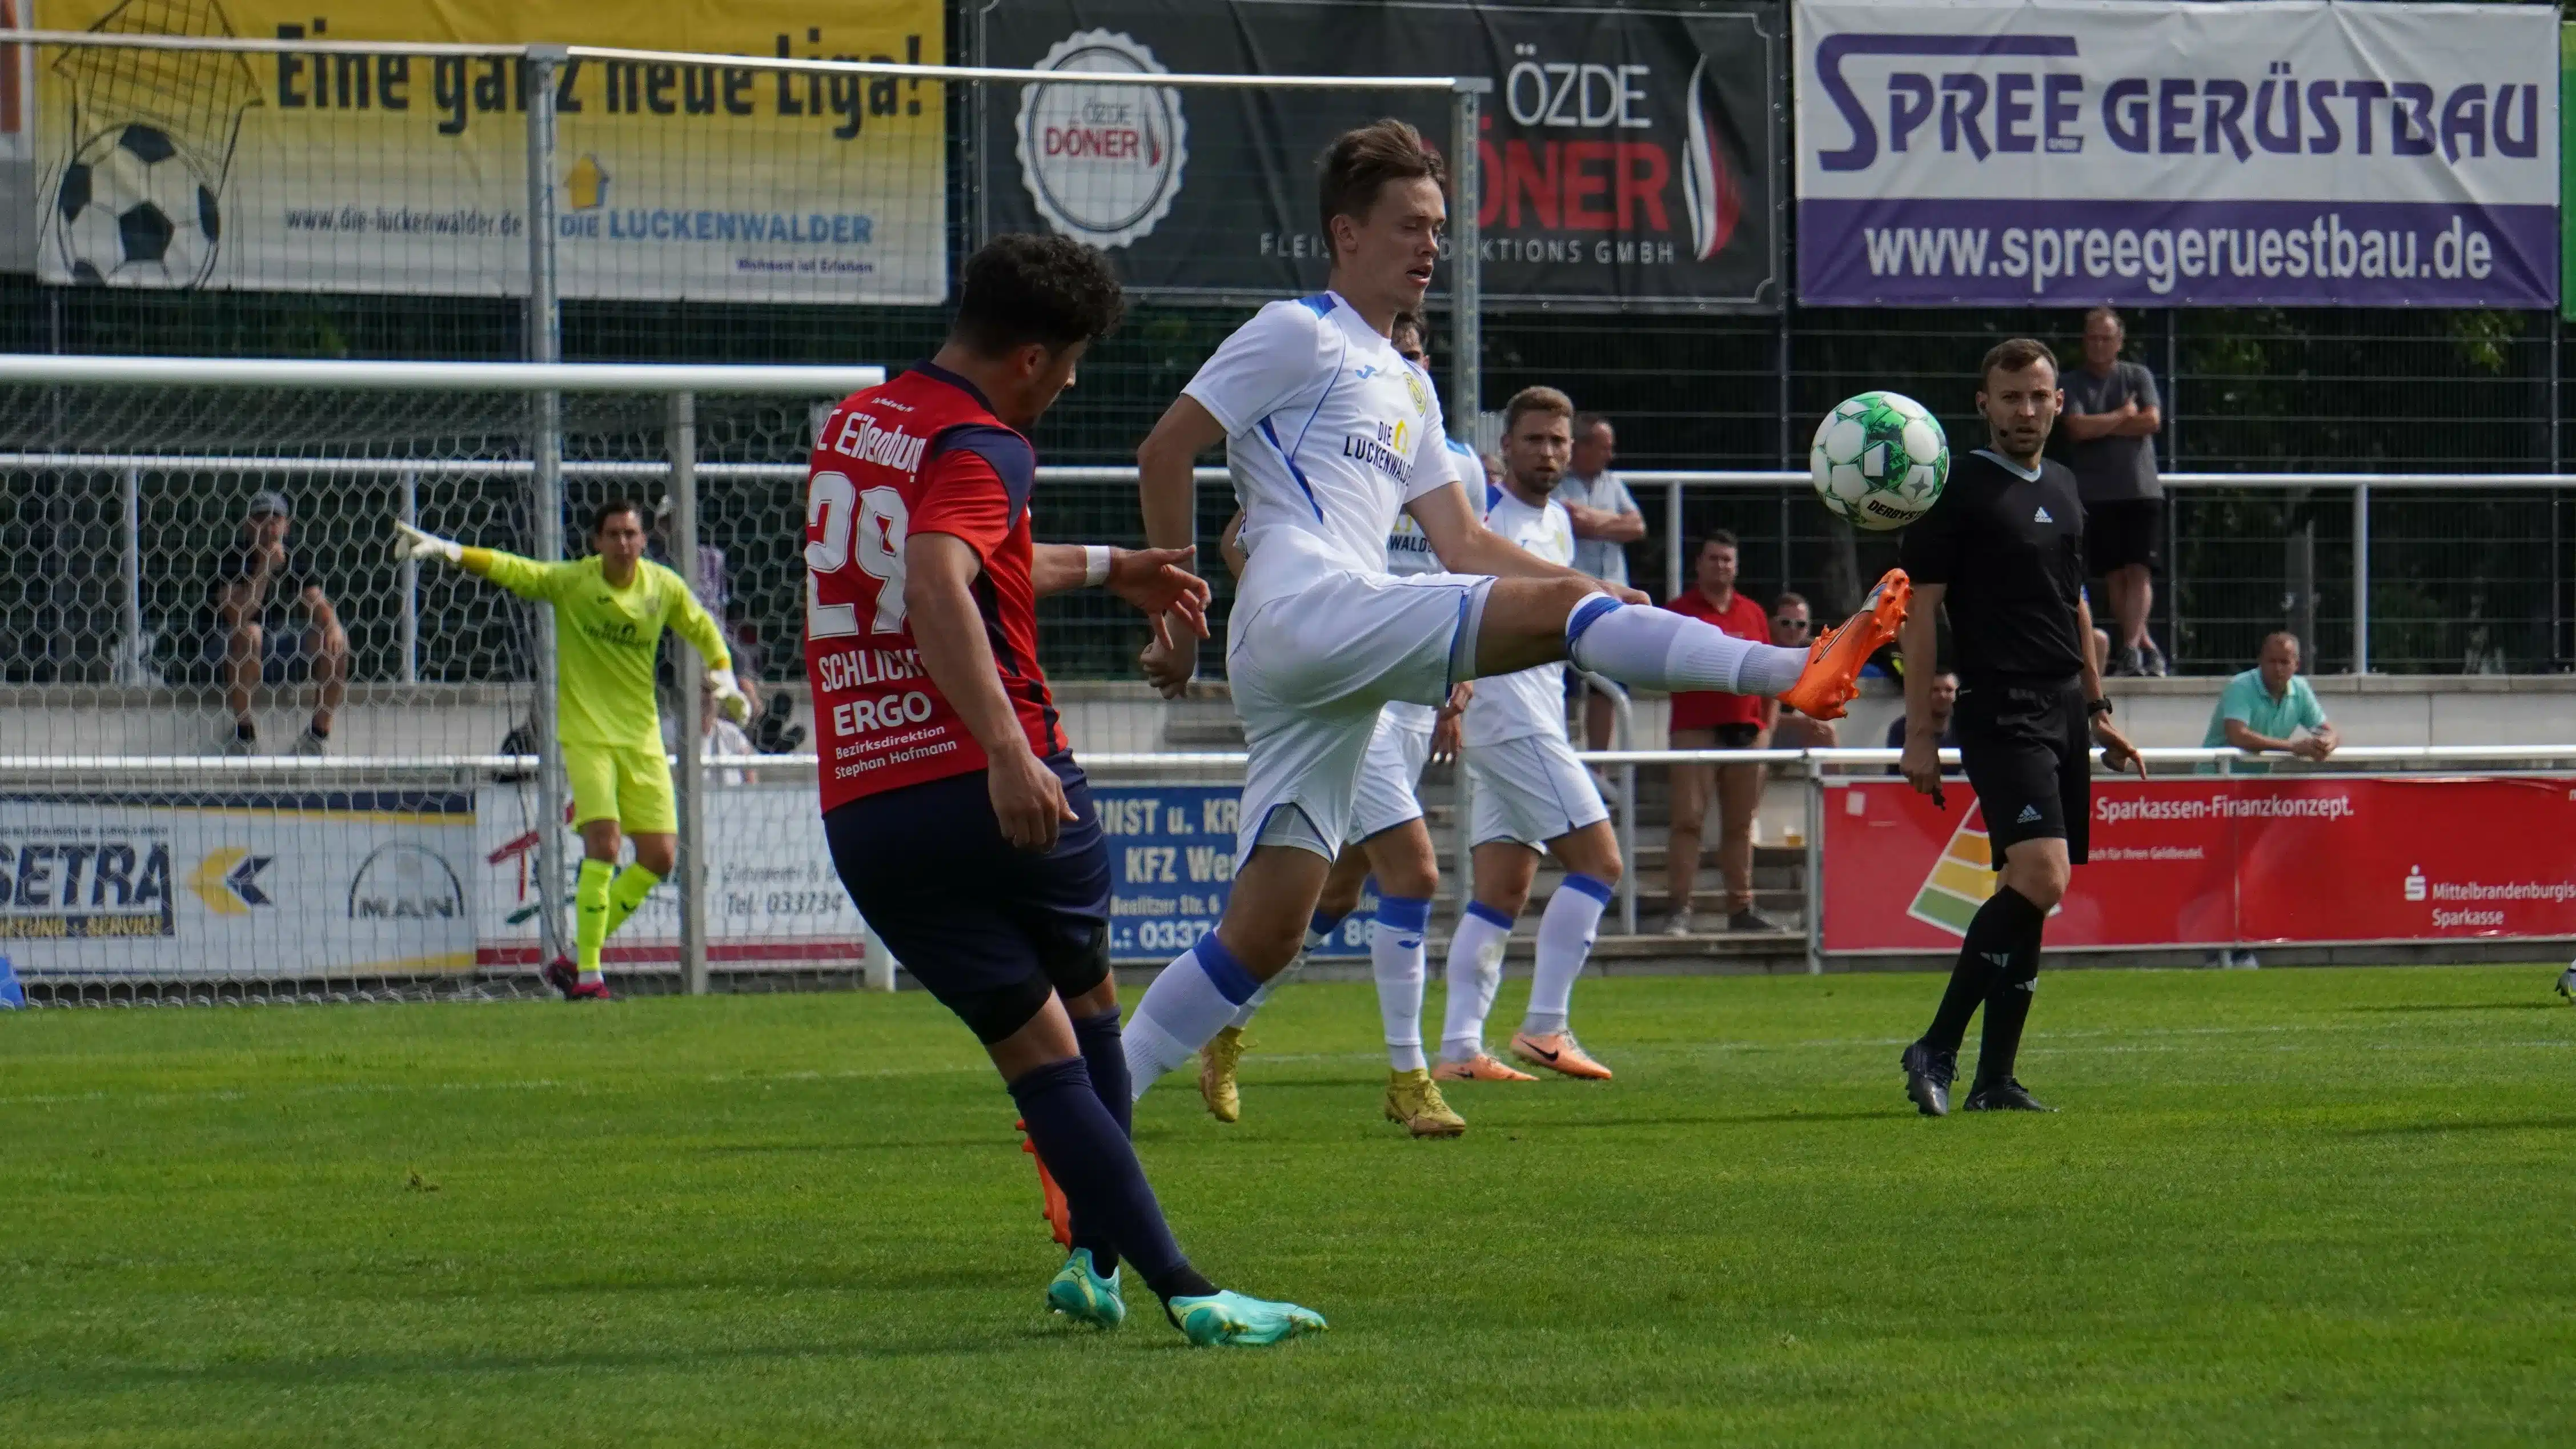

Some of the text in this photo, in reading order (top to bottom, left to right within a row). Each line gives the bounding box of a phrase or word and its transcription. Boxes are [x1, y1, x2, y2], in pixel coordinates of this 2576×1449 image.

[278, 19, 411, 110] Eine
[607, 53, 754, 115] neue
[776, 29, 922, 139] Liga!
[1507, 43, 1653, 128] ÖZDE
[1814, 33, 2538, 172] SPREE GERÜSTBAU
[1046, 116, 1139, 159] DÖNER
[609, 209, 873, 244] LUCKENWALDER
[1594, 240, 1675, 265] GMBH
[1864, 213, 2492, 294] www.spreegeruestbau.de
[1377, 420, 1393, 447] DIE
[804, 471, 909, 641] 29
[818, 648, 924, 693] SCHLICH
[833, 691, 932, 737] ERGO
[835, 740, 958, 780] Stephan Hofmann
[836, 725, 946, 760] Bezirksdirektion
[1166, 806, 1194, 834] u.
[2096, 793, 2354, 824] Sparkassen-Finanzkonzept.
[1125, 846, 1178, 883] KFZ
[359, 895, 455, 920] MAN
[2431, 908, 2505, 929] Sparkasse
